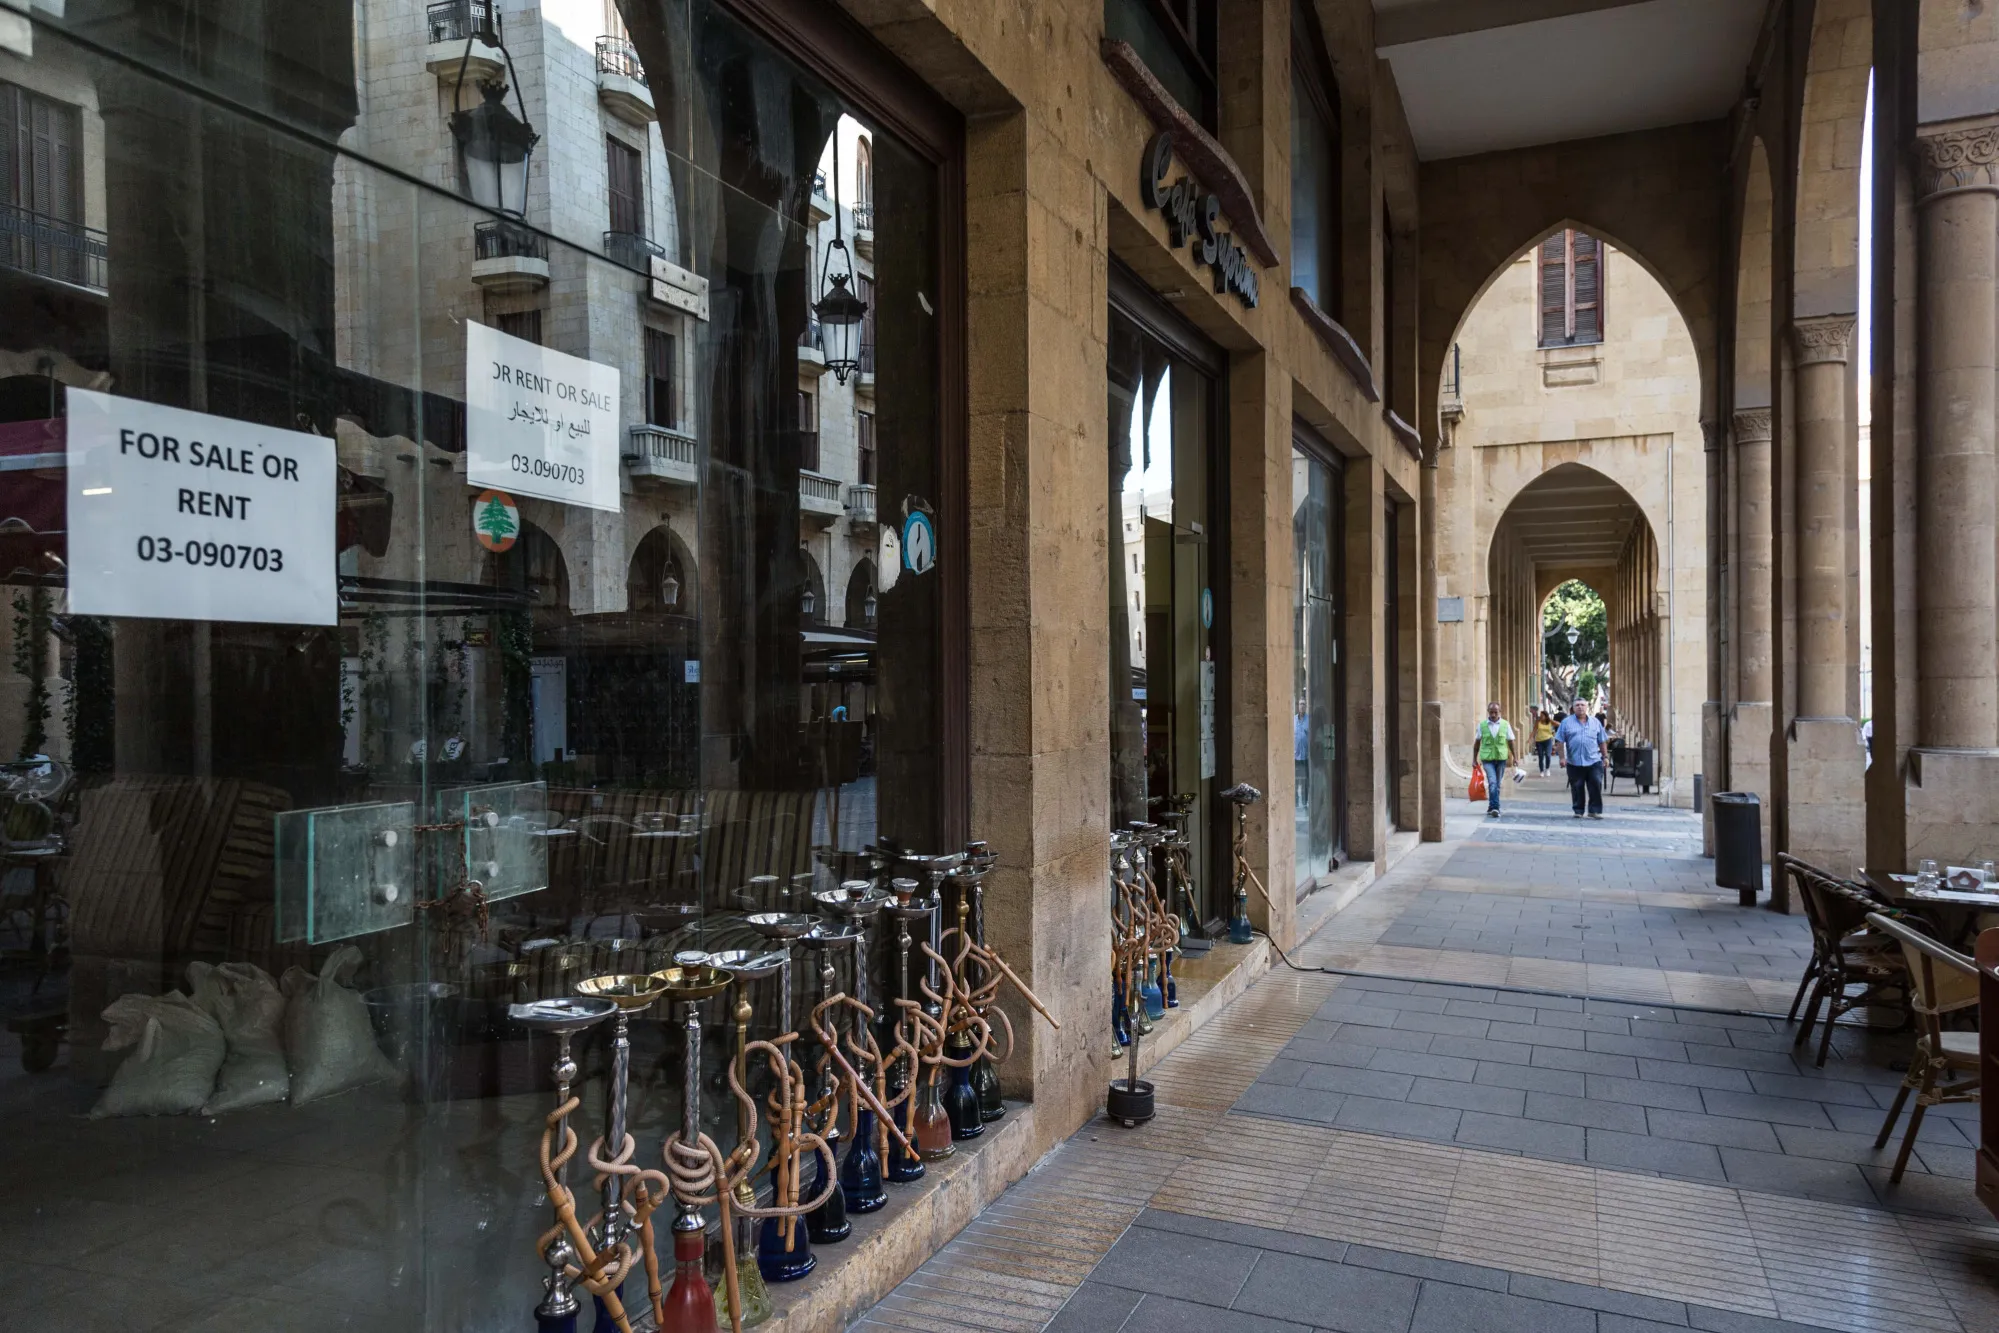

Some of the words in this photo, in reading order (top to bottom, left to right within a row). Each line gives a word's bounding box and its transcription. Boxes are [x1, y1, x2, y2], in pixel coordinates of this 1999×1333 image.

[516, 369, 552, 395] RENT
[556, 382, 577, 403] OR
[581, 388, 611, 412] SALE
[568, 418, 590, 439] للبيع
[119, 428, 180, 463] FOR
[189, 441, 255, 475] SALE
[262, 454, 299, 482] OR
[511, 453, 585, 485] 03.090703
[178, 488, 252, 520] RENT
[137, 535, 284, 572] 03-090703
